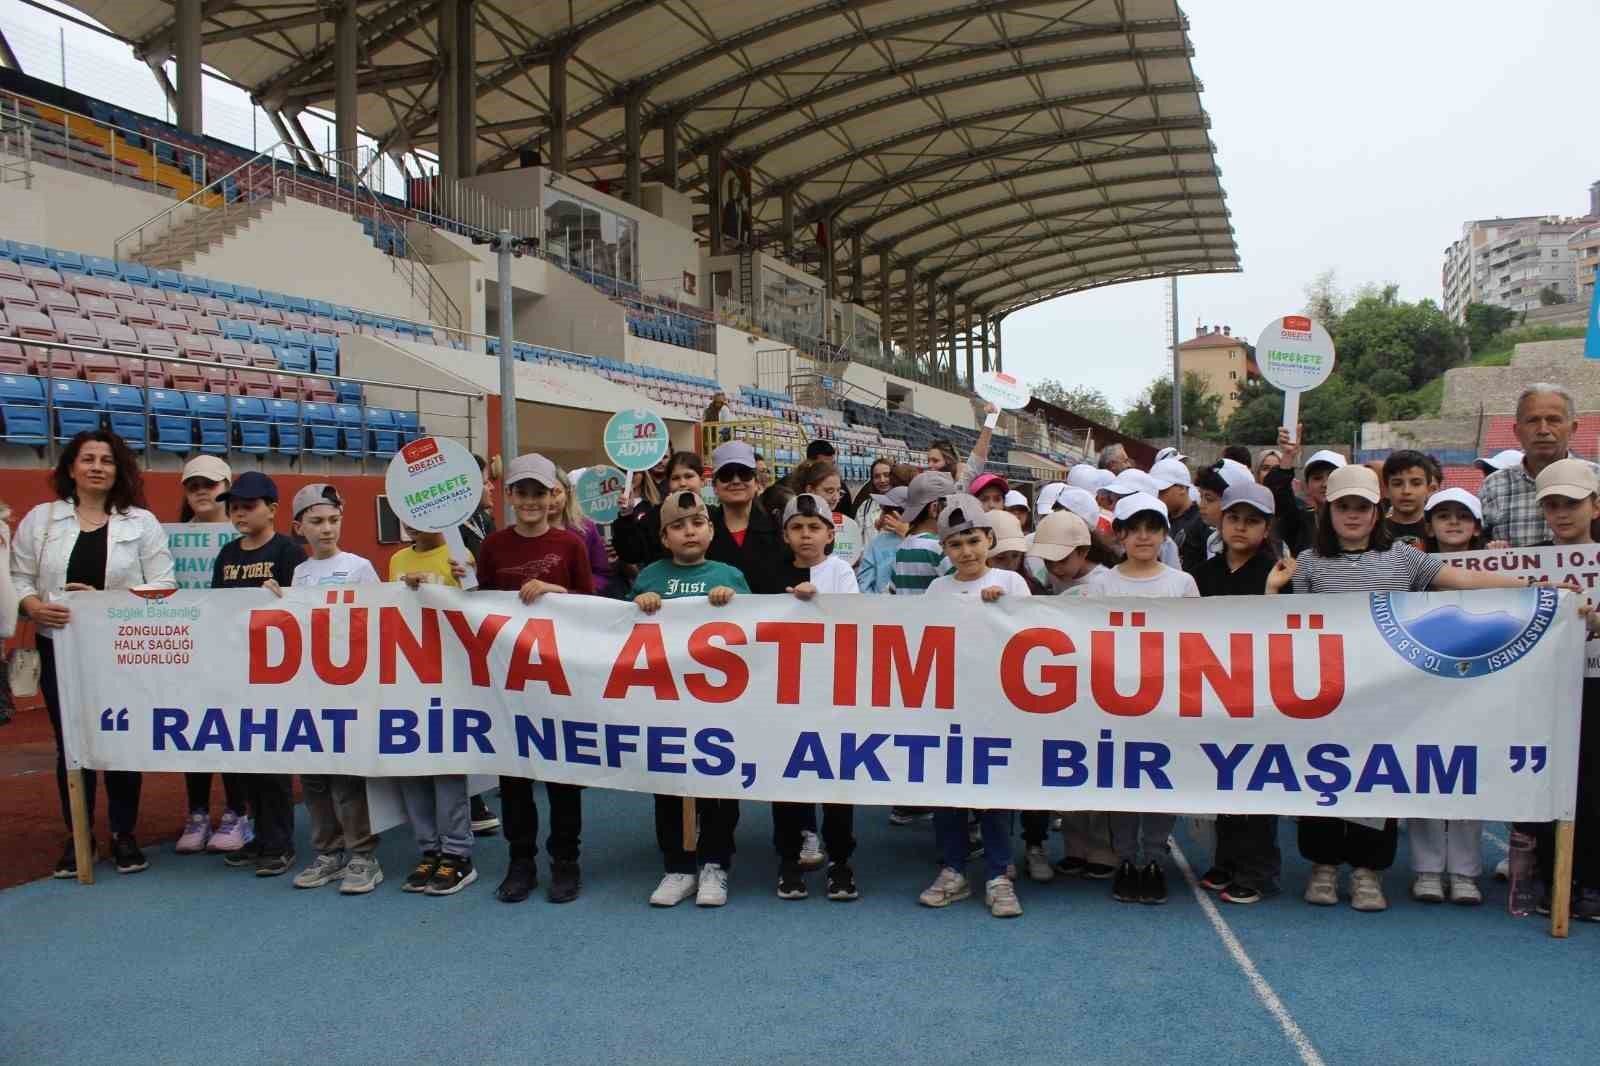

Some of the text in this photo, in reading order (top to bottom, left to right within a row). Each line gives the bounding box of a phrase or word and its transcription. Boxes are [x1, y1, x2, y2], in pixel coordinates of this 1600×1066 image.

[1441, 552, 1541, 571] ERGÜN
[242, 562, 275, 579] YORK
[664, 578, 707, 595] Just
[107, 606, 200, 621] Sağlık Bakanlığı
[118, 625, 190, 637] ZONGULDAK
[114, 639, 145, 650] HALK
[250, 590, 1344, 718] DÜNYA ASTIM GÜNÜ
[153, 708, 357, 753] RAHAT
[379, 697, 494, 755] BİR
[515, 715, 757, 789] NEFES,
[784, 724, 1012, 785] AKTİF
[1041, 728, 1174, 790] BİR
[1204, 743, 1478, 807] YAŞAM
